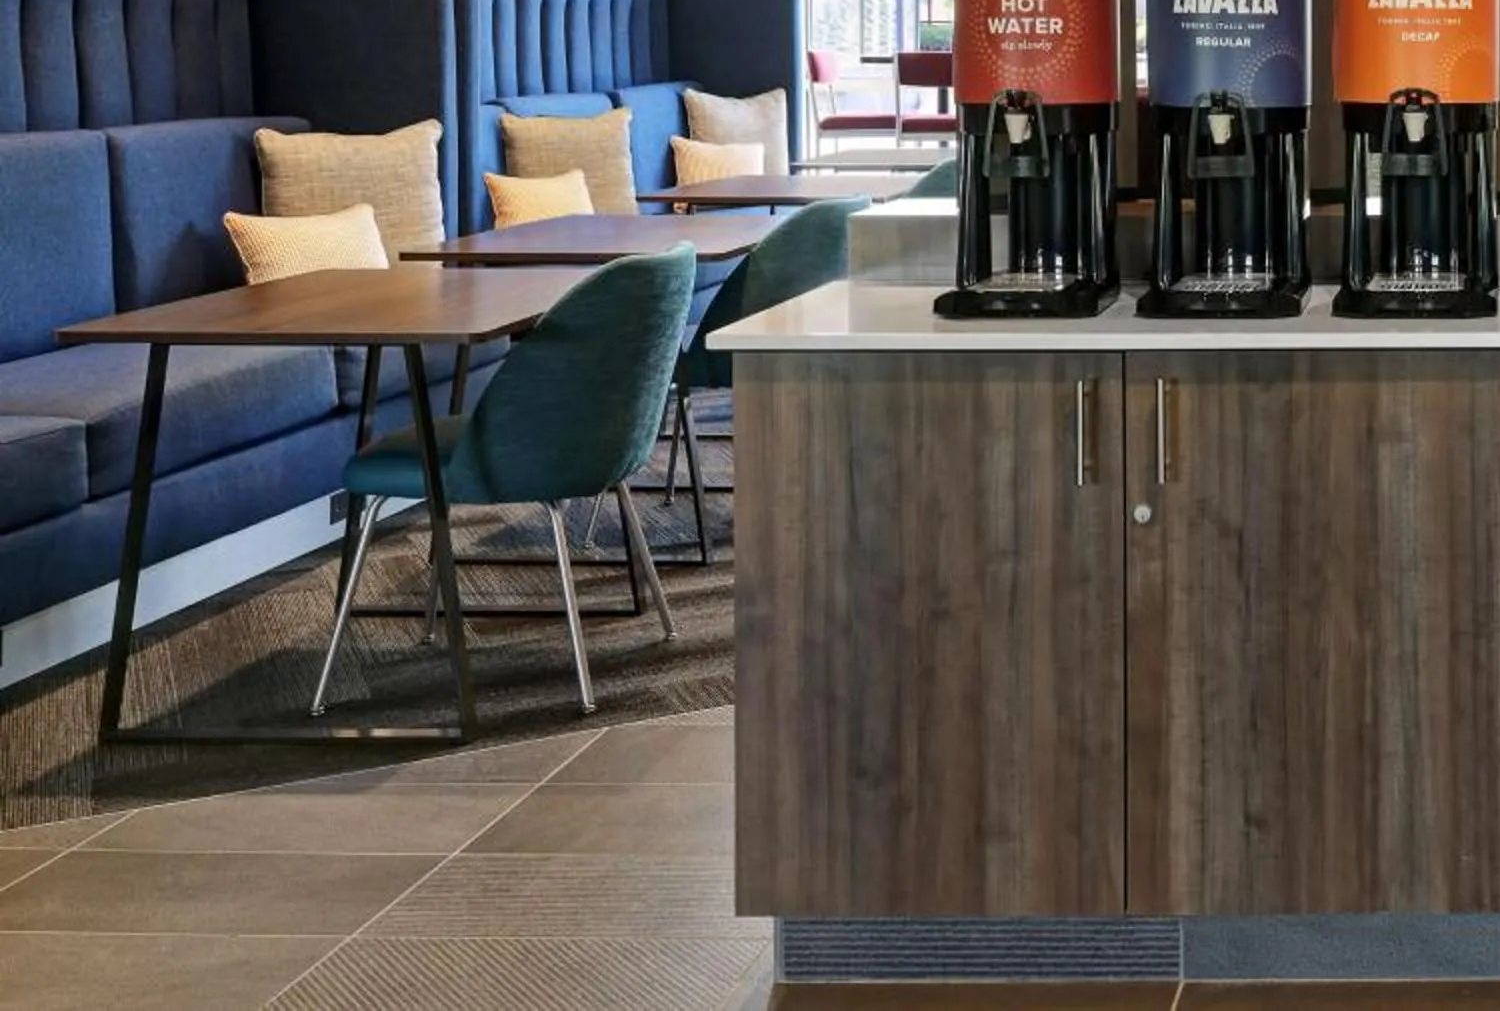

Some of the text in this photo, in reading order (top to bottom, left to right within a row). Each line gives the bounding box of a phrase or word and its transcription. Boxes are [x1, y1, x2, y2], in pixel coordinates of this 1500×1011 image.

[987, 16, 1064, 34] WATER
[1195, 36, 1251, 47] REGULAR
[1401, 30, 1440, 42] DECAF
